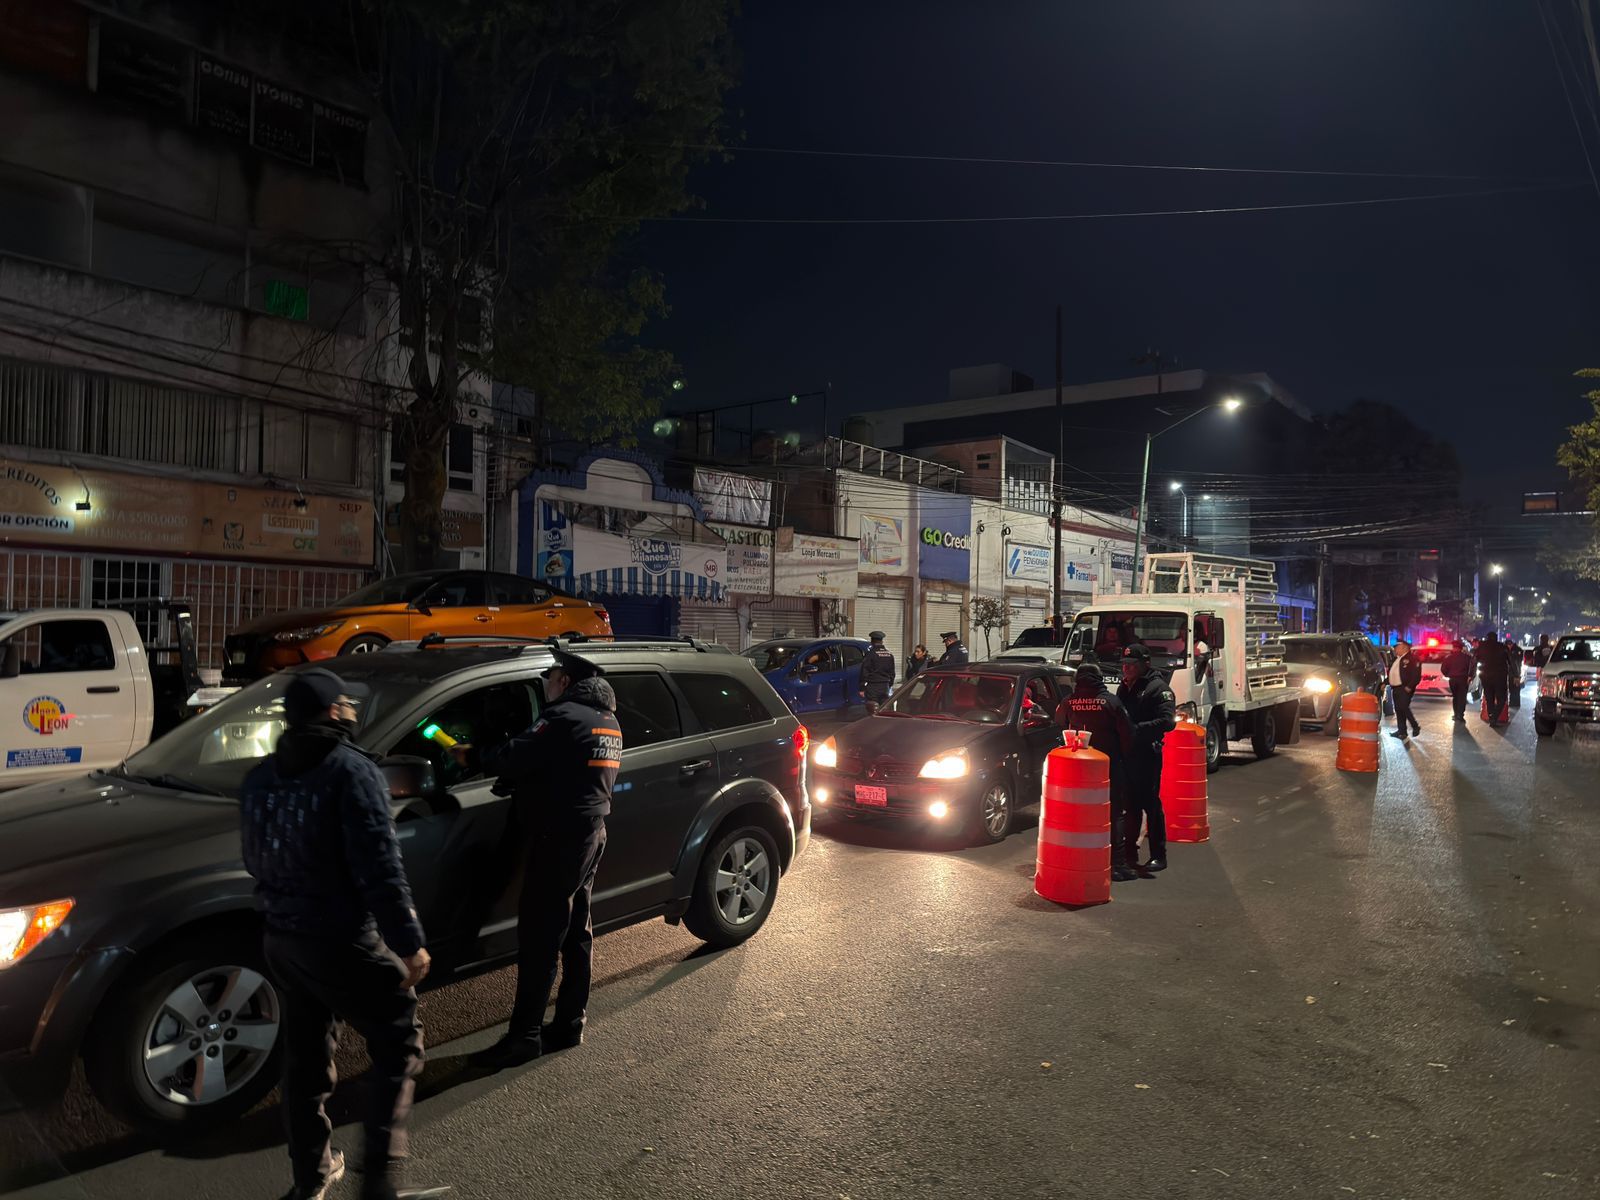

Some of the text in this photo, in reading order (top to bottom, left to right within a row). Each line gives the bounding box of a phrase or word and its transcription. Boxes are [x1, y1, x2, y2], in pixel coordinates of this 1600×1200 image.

[339, 503, 362, 513] SEP
[15, 515, 69, 529] OPCIÓN
[923, 527, 943, 545] GO
